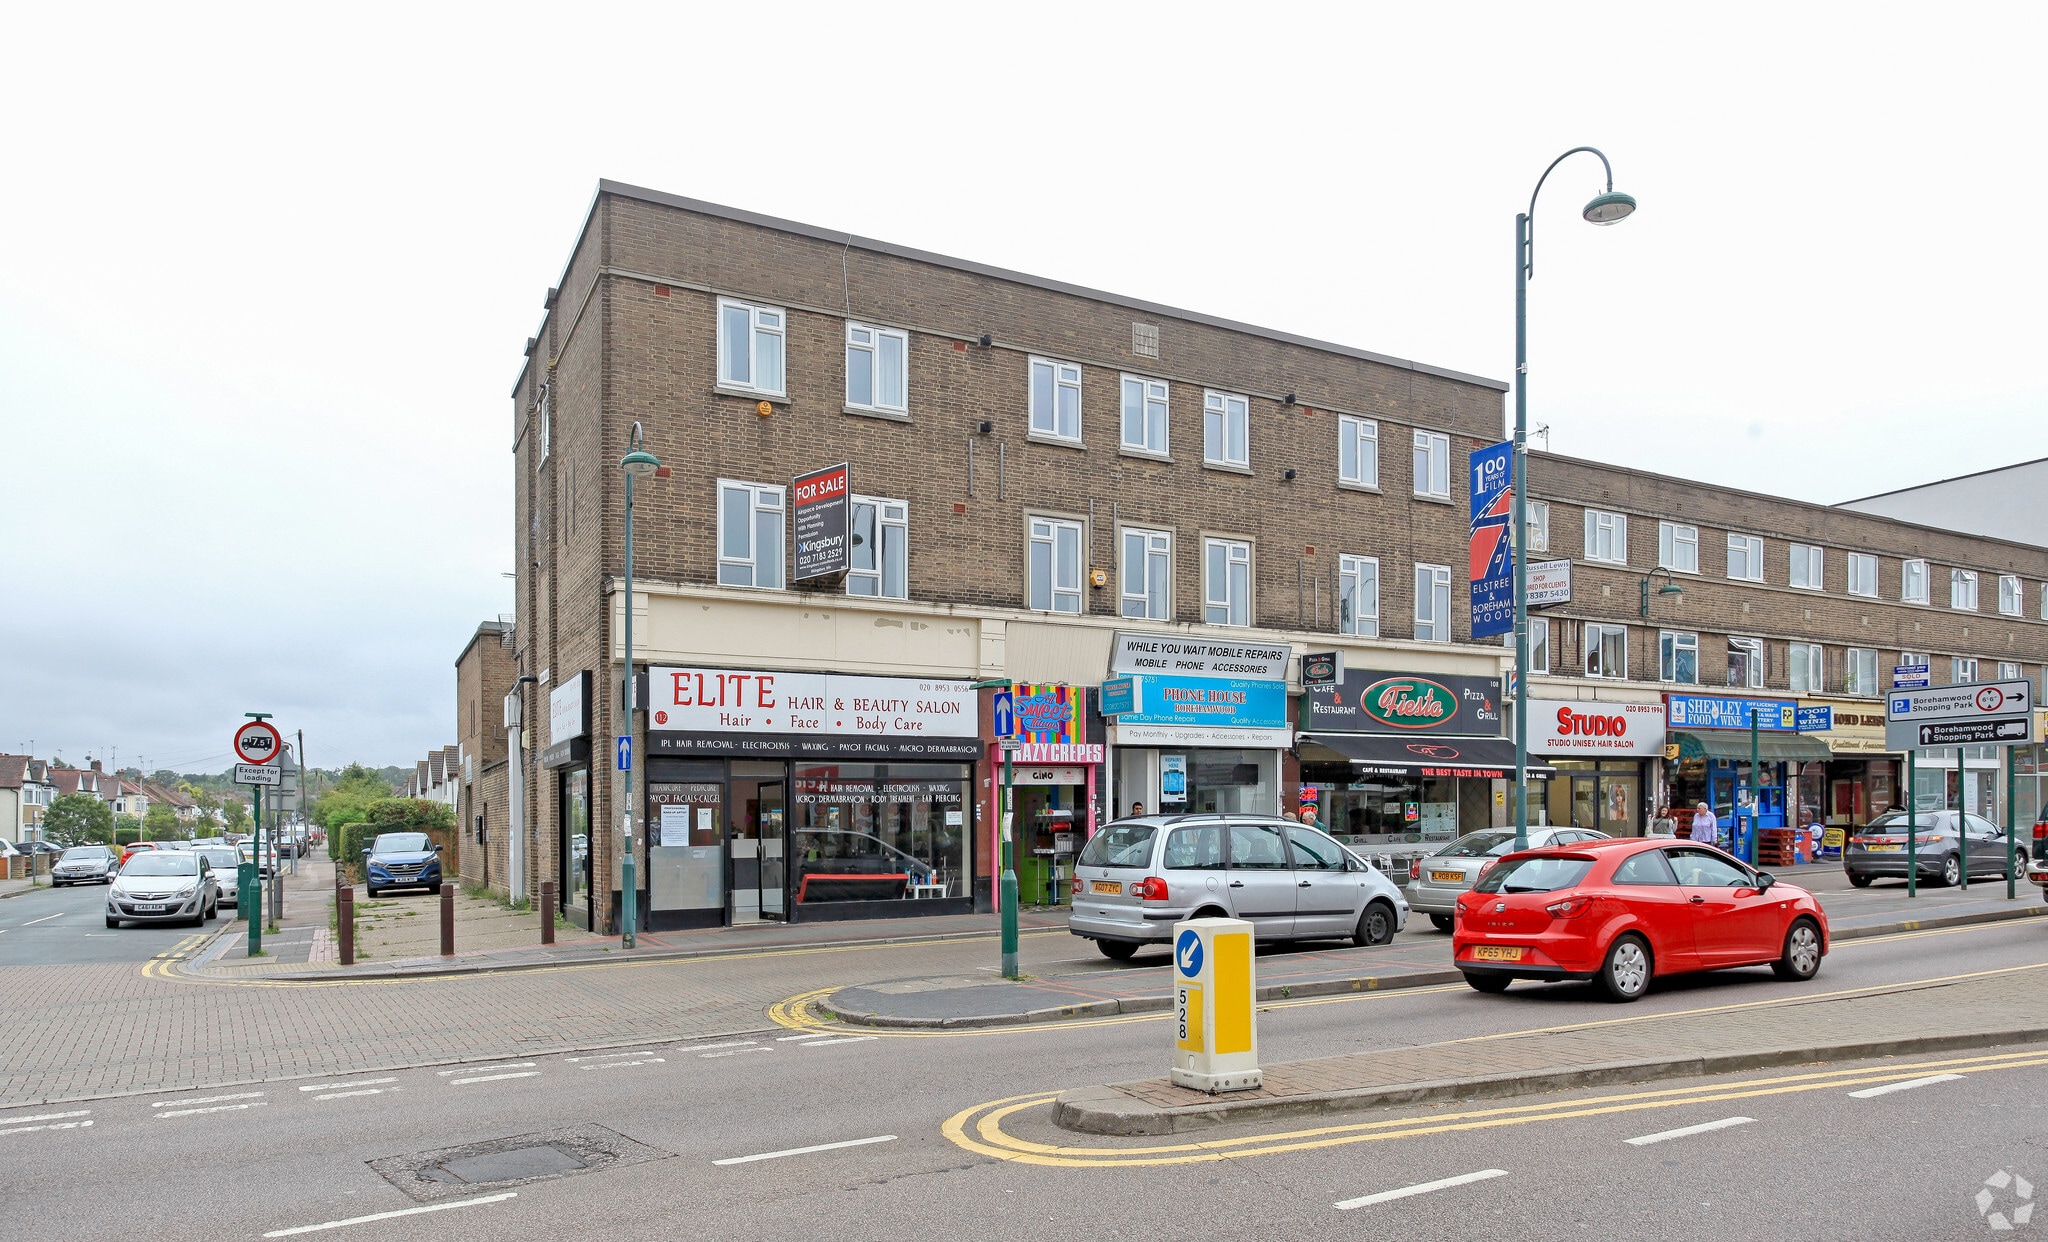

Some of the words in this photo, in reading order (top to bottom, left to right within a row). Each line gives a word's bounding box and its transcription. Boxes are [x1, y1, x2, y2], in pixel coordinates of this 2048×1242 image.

[1474, 456, 1506, 495] 100
[1485, 472, 1499, 483] YEARS
[1500, 470, 1505, 478] OF
[797, 484, 816, 500] FOR
[820, 476, 844, 494] SALE
[1485, 478, 1505, 492] FILM
[816, 499, 843, 510] Development
[804, 534, 844, 552] Kingsbury
[800, 556, 810, 564] 020
[813, 552, 826, 561] 7183
[828, 548, 842, 558] 2529
[1473, 577, 1510, 594] ELSTREE
[1489, 592, 1495, 600] &
[1473, 599, 1510, 614] BOREHAM
[1473, 609, 1510, 623] WOOD
[1127, 641, 1158, 653] WHILE
[1161, 644, 1180, 653] YOU
[1184, 645, 1206, 656] WAIT
[1207, 647, 1242, 658] MOBILE
[1244, 649, 1282, 660] REPAIRS
[1135, 658, 1167, 668] MOBILE
[1176, 660, 1204, 670] PHONE
[1212, 664, 1267, 673] ACCESSORIES
[670, 672, 776, 708] ELITE
[935, 684, 950, 692] 8953
[1230, 681, 1250, 689] Quality
[1272, 682, 1284, 690] Sold
[1164, 688, 1204, 702] PHONE
[1208, 690, 1246, 704] HOUSE
[1334, 692, 1342, 704] &
[1464, 689, 1485, 700] PIZZA
[1914, 694, 1972, 704] Borehamwood
[788, 697, 825, 710] HAIR
[834, 698, 844, 710] &
[854, 699, 908, 712] BEAUTY
[917, 701, 960, 713] SALON
[1378, 685, 1444, 718] Fiesta
[1484, 699, 1492, 711] &
[1688, 699, 1742, 715] SHENLEY
[1895, 701, 1904, 712] P
[1014, 698, 1073, 720] Sweet
[1174, 704, 1236, 714] BOREHAMWOOD
[1313, 702, 1356, 714] RESTAURANT
[1913, 704, 1950, 712] Shopping
[655, 713, 667, 722] 112
[1140, 714, 1152, 722] Day
[1175, 715, 1196, 723] Repairs
[1477, 709, 1498, 720] GRILL
[1688, 714, 1711, 724] FOOD
[1720, 716, 1742, 726] WINE
[720, 713, 751, 726] Hair
[791, 715, 819, 728] Face
[856, 716, 886, 734] Body
[895, 718, 922, 730] Care
[1031, 718, 1058, 730] Things
[1557, 706, 1626, 737] STUDIO
[1934, 724, 1994, 734] Borehamwood
[252, 738, 265, 746] 7.5
[1175, 732, 1204, 740] Upgrades
[1934, 734, 1971, 742] Shopping
[743, 741, 790, 750] ELECTROLYSIS
[928, 745, 977, 753] DERMABRASION
[1548, 739, 1570, 747] STUDIO
[1051, 744, 1101, 762] CREPES
[244, 774, 271, 782] loading
[1421, 768, 1434, 776] THE
[1436, 768, 1451, 776] BEST
[1453, 769, 1472, 777] TASTE
[1483, 770, 1503, 778] TOWN
[830, 784, 843, 792] HAIR
[846, 784, 874, 792] REMOVAL
[929, 784, 950, 792] WAXING
[890, 795, 915, 803] TREATMENT
[936, 794, 960, 802] PIERCING
[1450, 872, 1462, 880] KSF
[1477, 947, 1498, 957] KP65
[1502, 948, 1518, 958] YHJ
